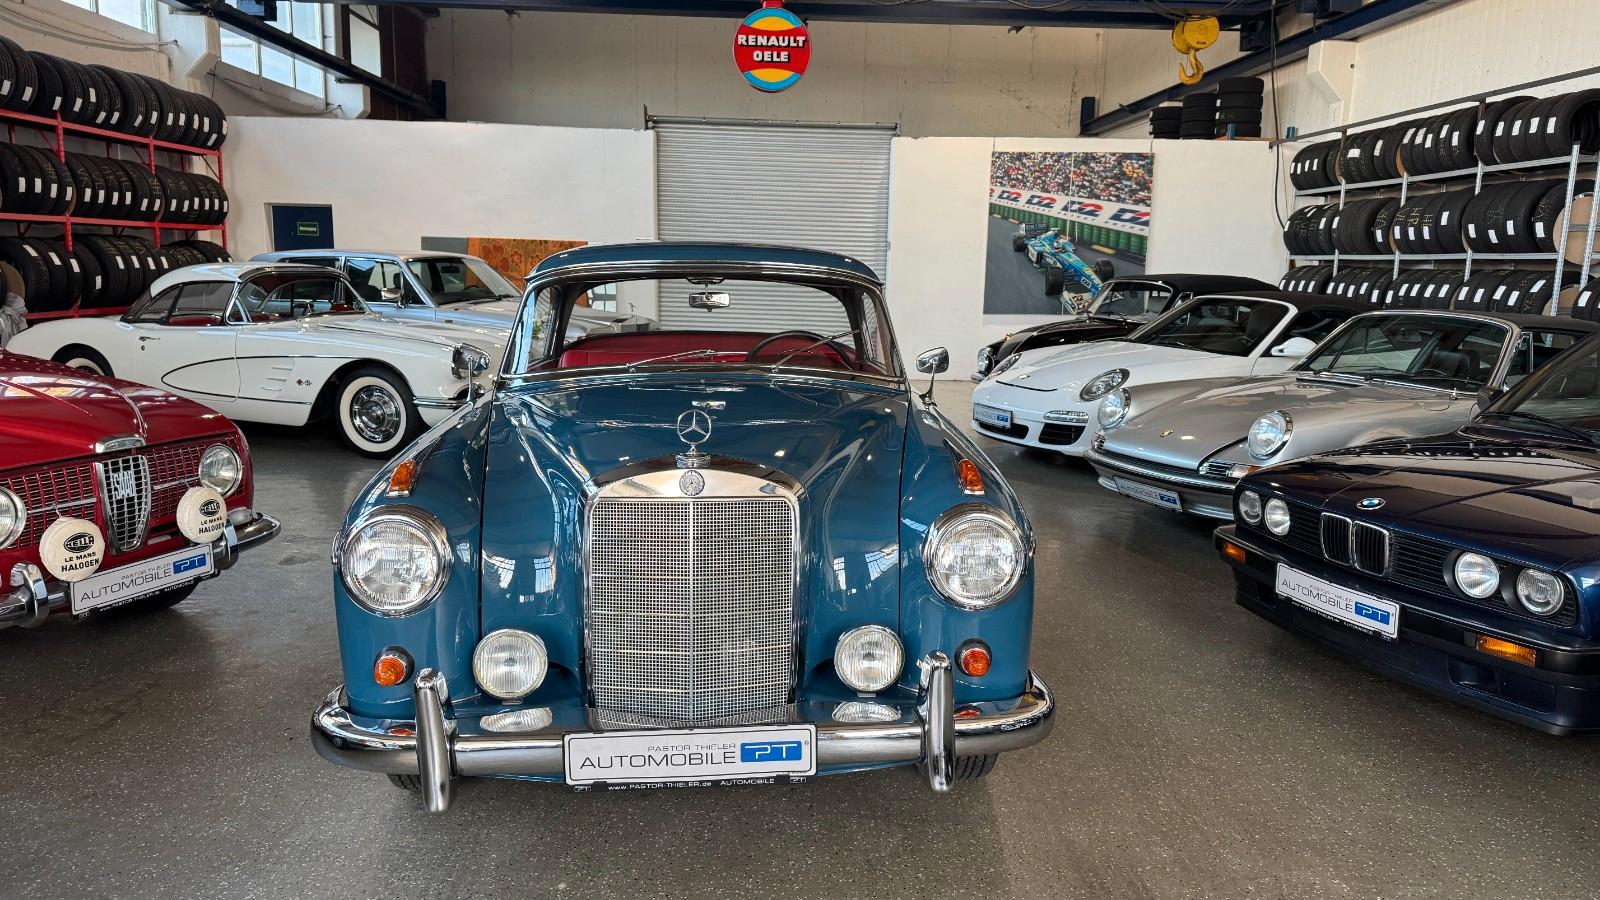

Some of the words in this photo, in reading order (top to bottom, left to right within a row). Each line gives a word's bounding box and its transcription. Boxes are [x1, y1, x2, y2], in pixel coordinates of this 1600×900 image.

[737, 35, 806, 48] RENAULT
[752, 50, 790, 62] OELE
[114, 471, 135, 499] SAAB
[64, 535, 94, 548] HELLA
[76, 552, 96, 560] MANS
[61, 558, 100, 572] HALOGEN
[80, 568, 172, 602] AUTOMOBILE
[175, 555, 204, 570] PT
[1281, 579, 1353, 613] AUTOMOBILE
[1357, 603, 1387, 620] PT
[579, 751, 737, 769] AUTOMOBILE
[745, 744, 797, 760] PT
[721, 778, 775, 786] AUTOMOBILE
